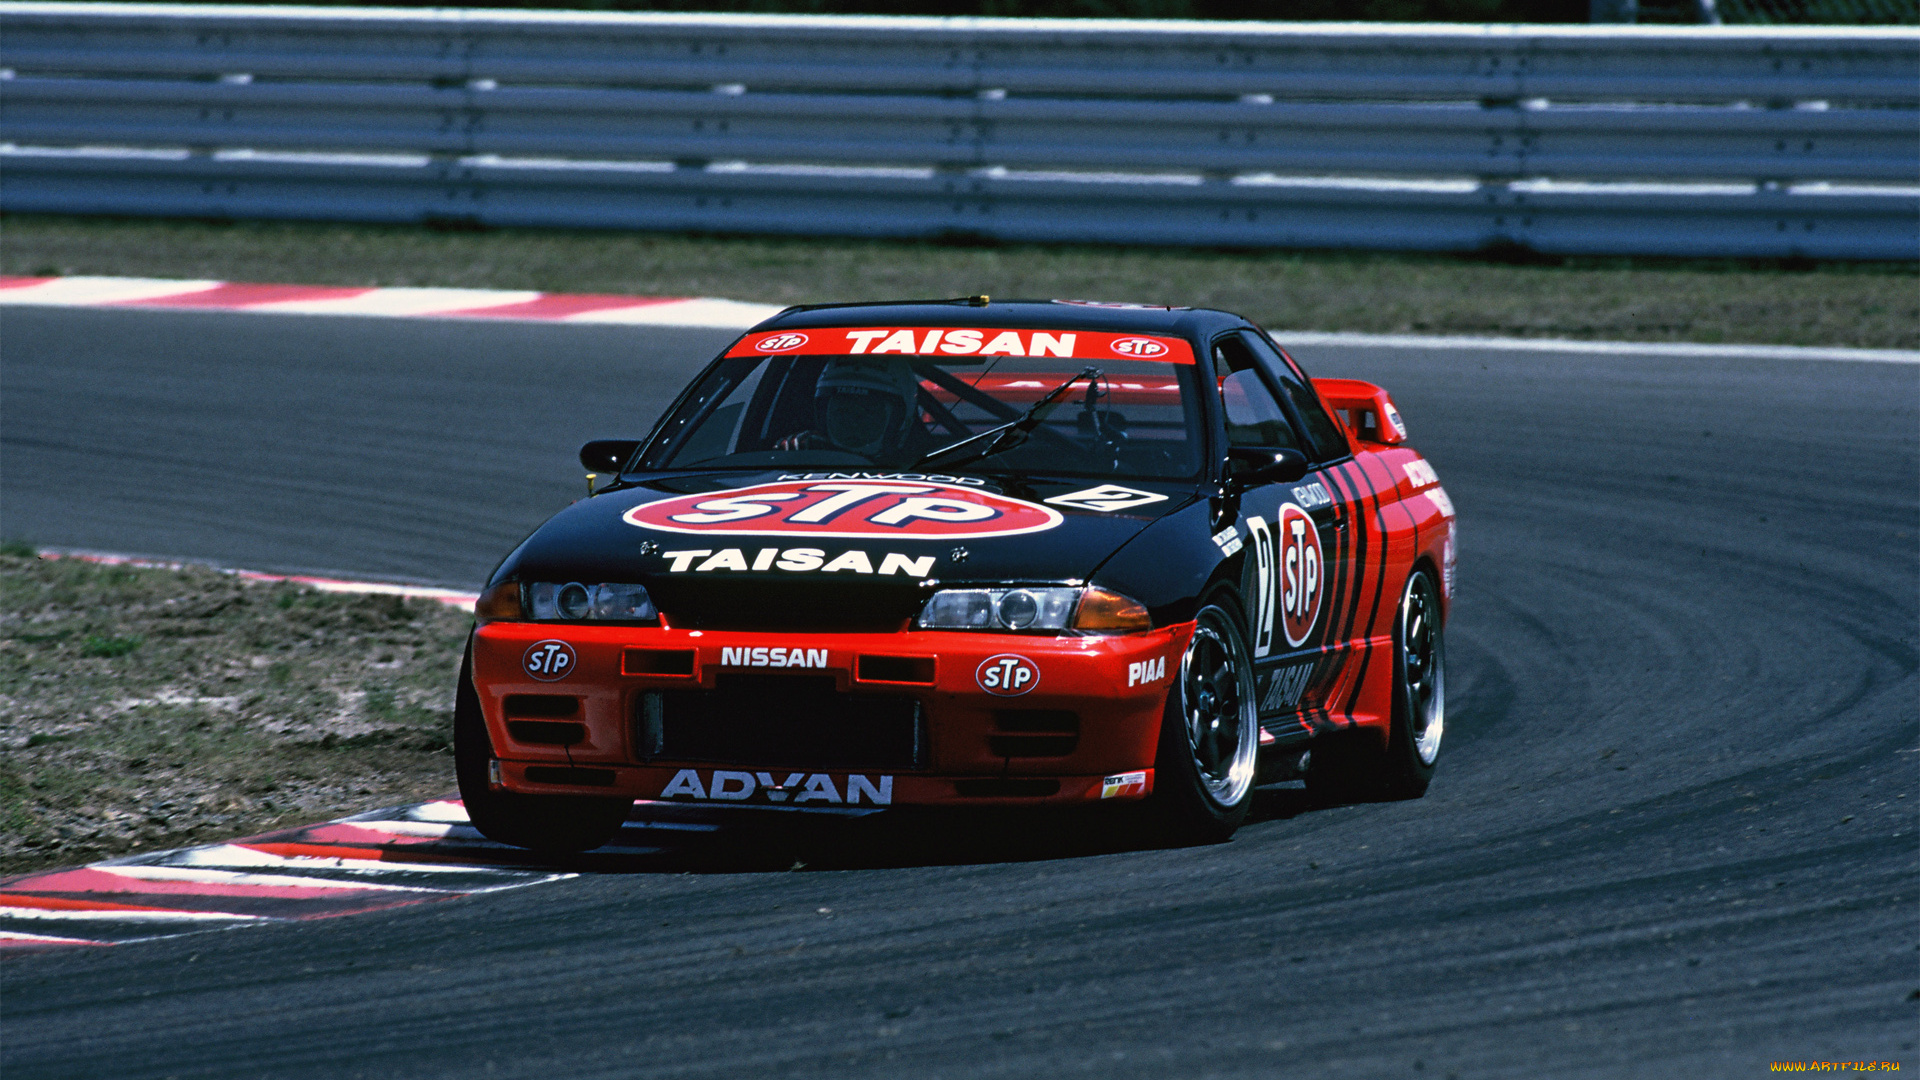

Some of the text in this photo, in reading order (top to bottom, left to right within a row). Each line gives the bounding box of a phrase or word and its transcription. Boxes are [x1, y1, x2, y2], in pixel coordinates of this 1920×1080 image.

[762, 334, 804, 351] STP
[846, 329, 1076, 357] TAISAN
[1117, 338, 1160, 356] STP
[778, 472, 985, 485] KENWOOD
[672, 485, 996, 524] STP
[662, 547, 937, 577] TAISAN
[1285, 519, 1317, 618] STP
[528, 644, 569, 674] STP
[721, 647, 828, 669] NISSAN
[1128, 656, 1165, 687] PIAA
[984, 658, 1031, 689] STP
[660, 768, 893, 805] ADVAN
